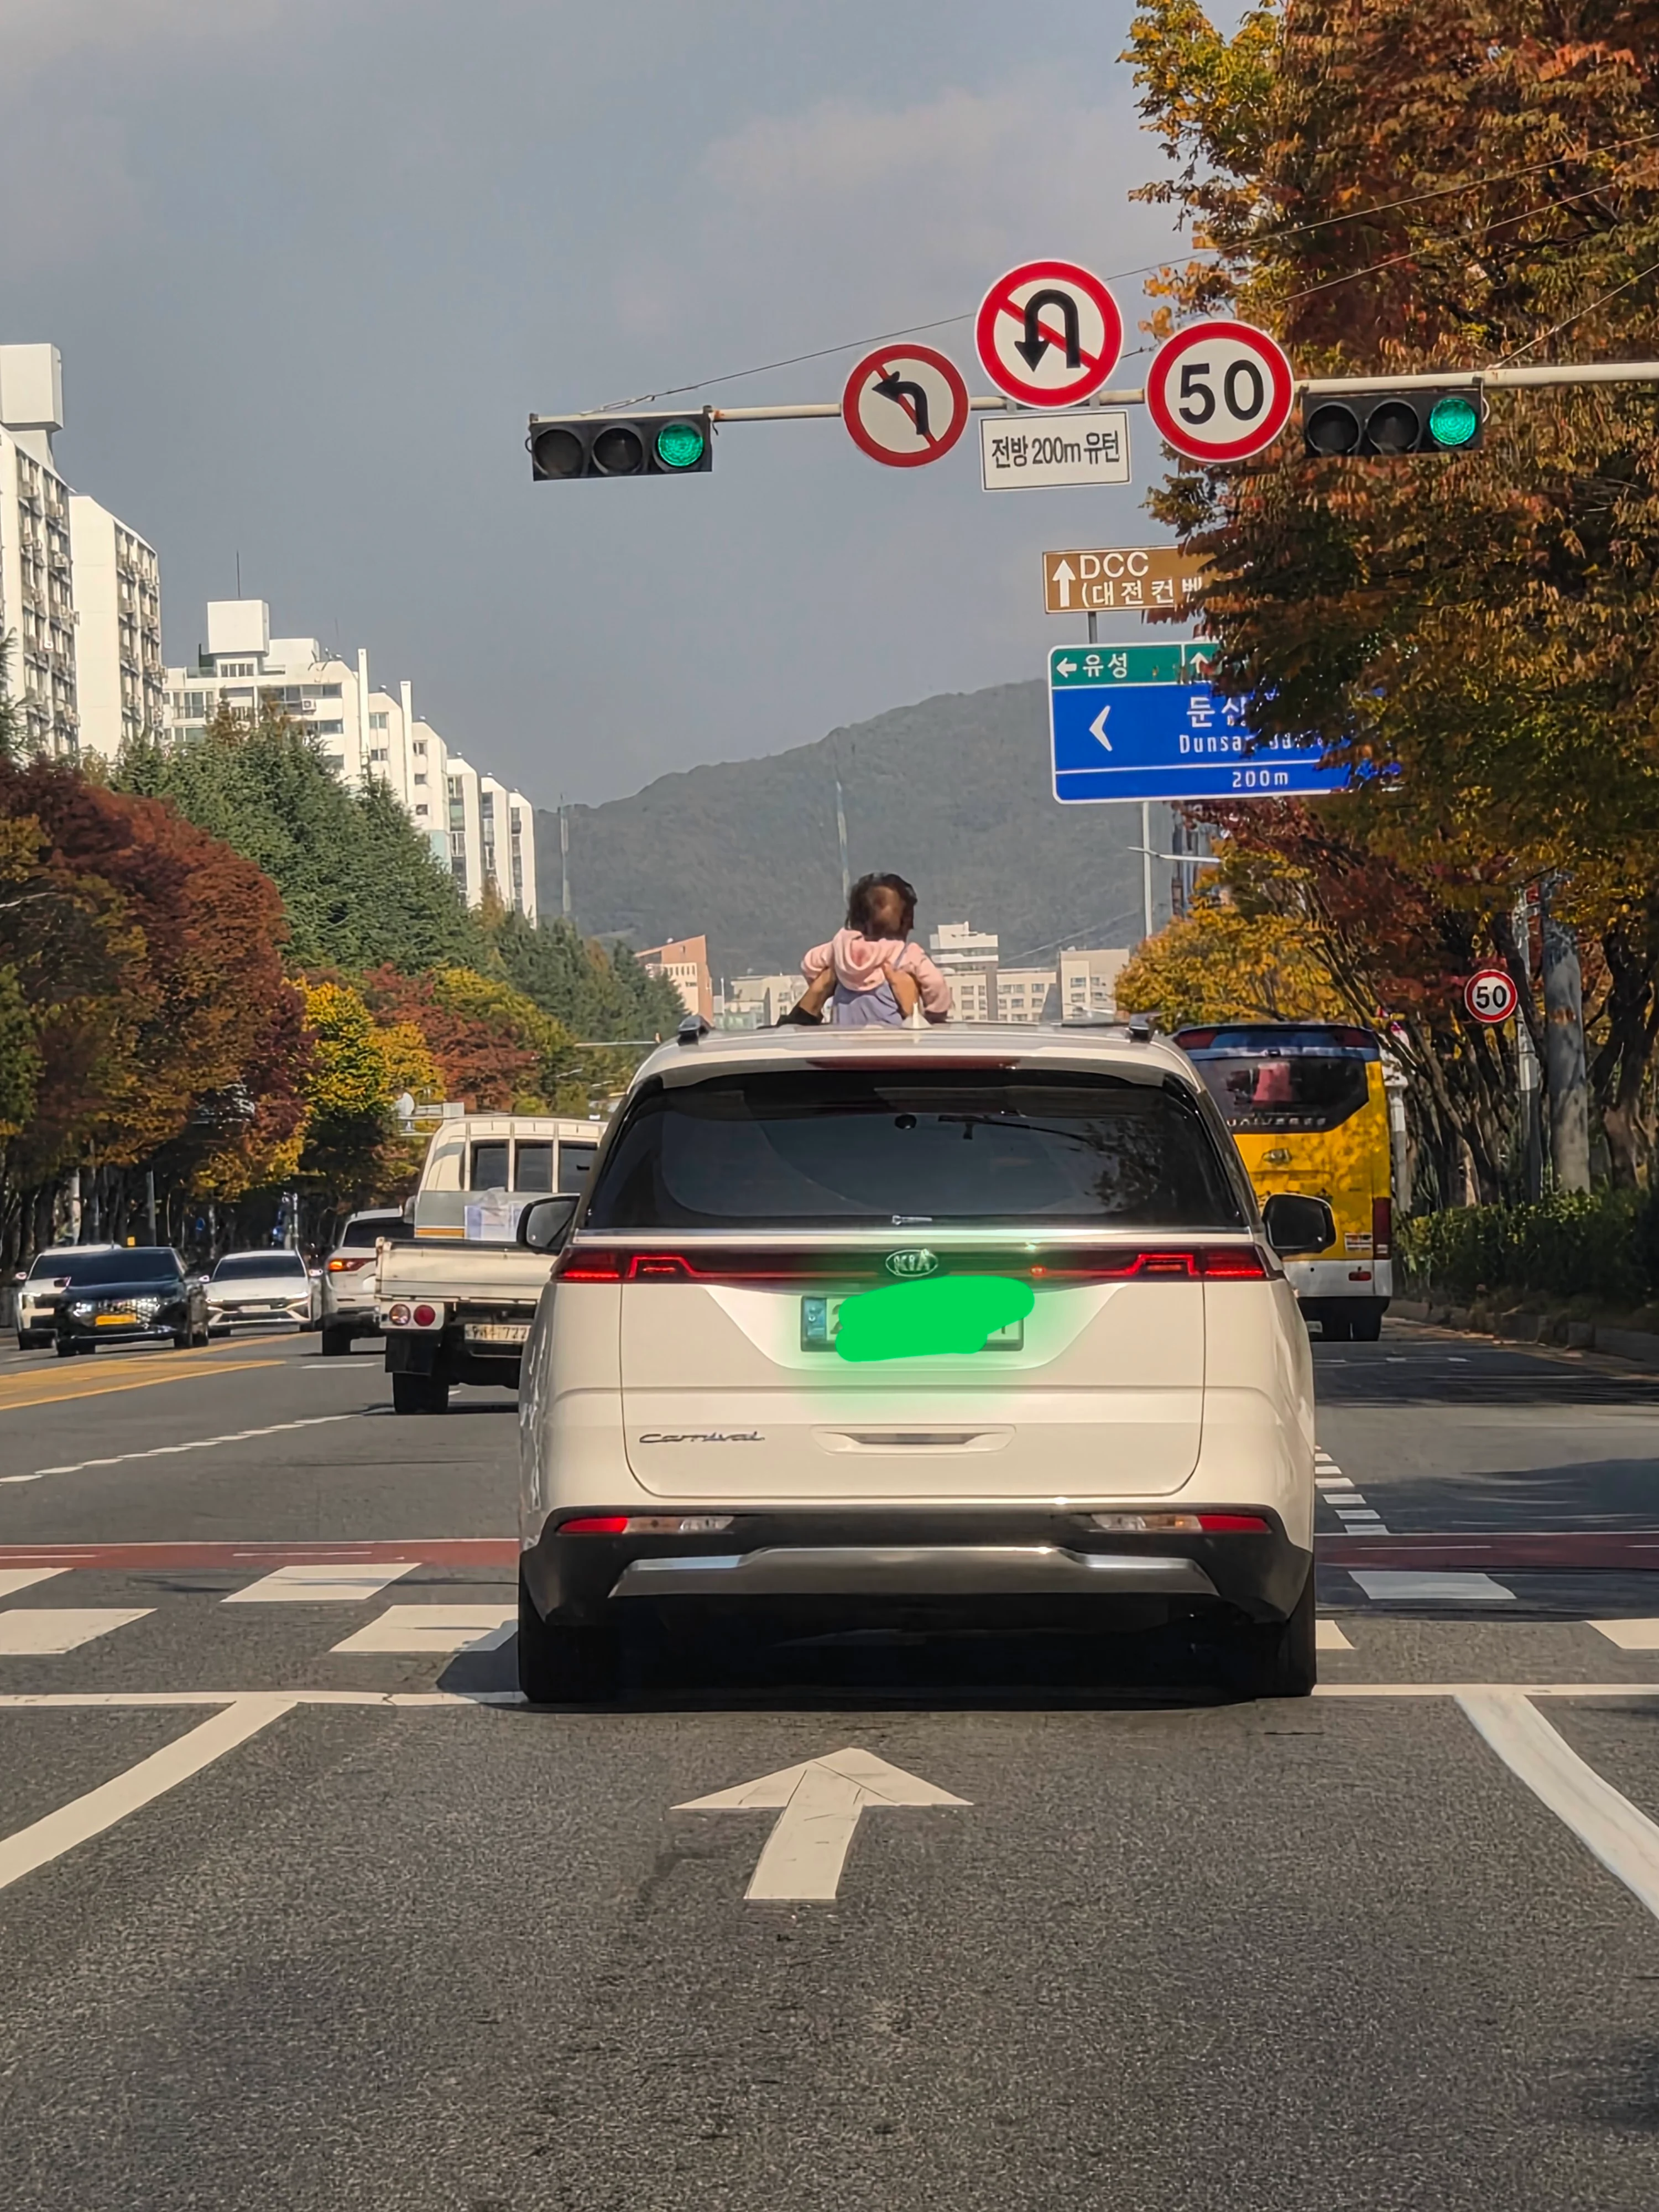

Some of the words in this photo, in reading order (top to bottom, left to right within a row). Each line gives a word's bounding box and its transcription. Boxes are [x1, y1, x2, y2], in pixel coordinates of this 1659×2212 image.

[1179, 359, 1264, 425] 50
[992, 435, 1029, 468] 전방
[1031, 437, 1081, 465] 200m
[1083, 430, 1120, 465] 유턴
[1080, 552, 1149, 580] DCC
[1082, 653, 1127, 679] 유성
[1232, 770, 1288, 788] 200m
[1476, 985, 1507, 1009] 50
[892, 1251, 931, 1274] KIA
[639, 1431, 765, 1443] Carnival
